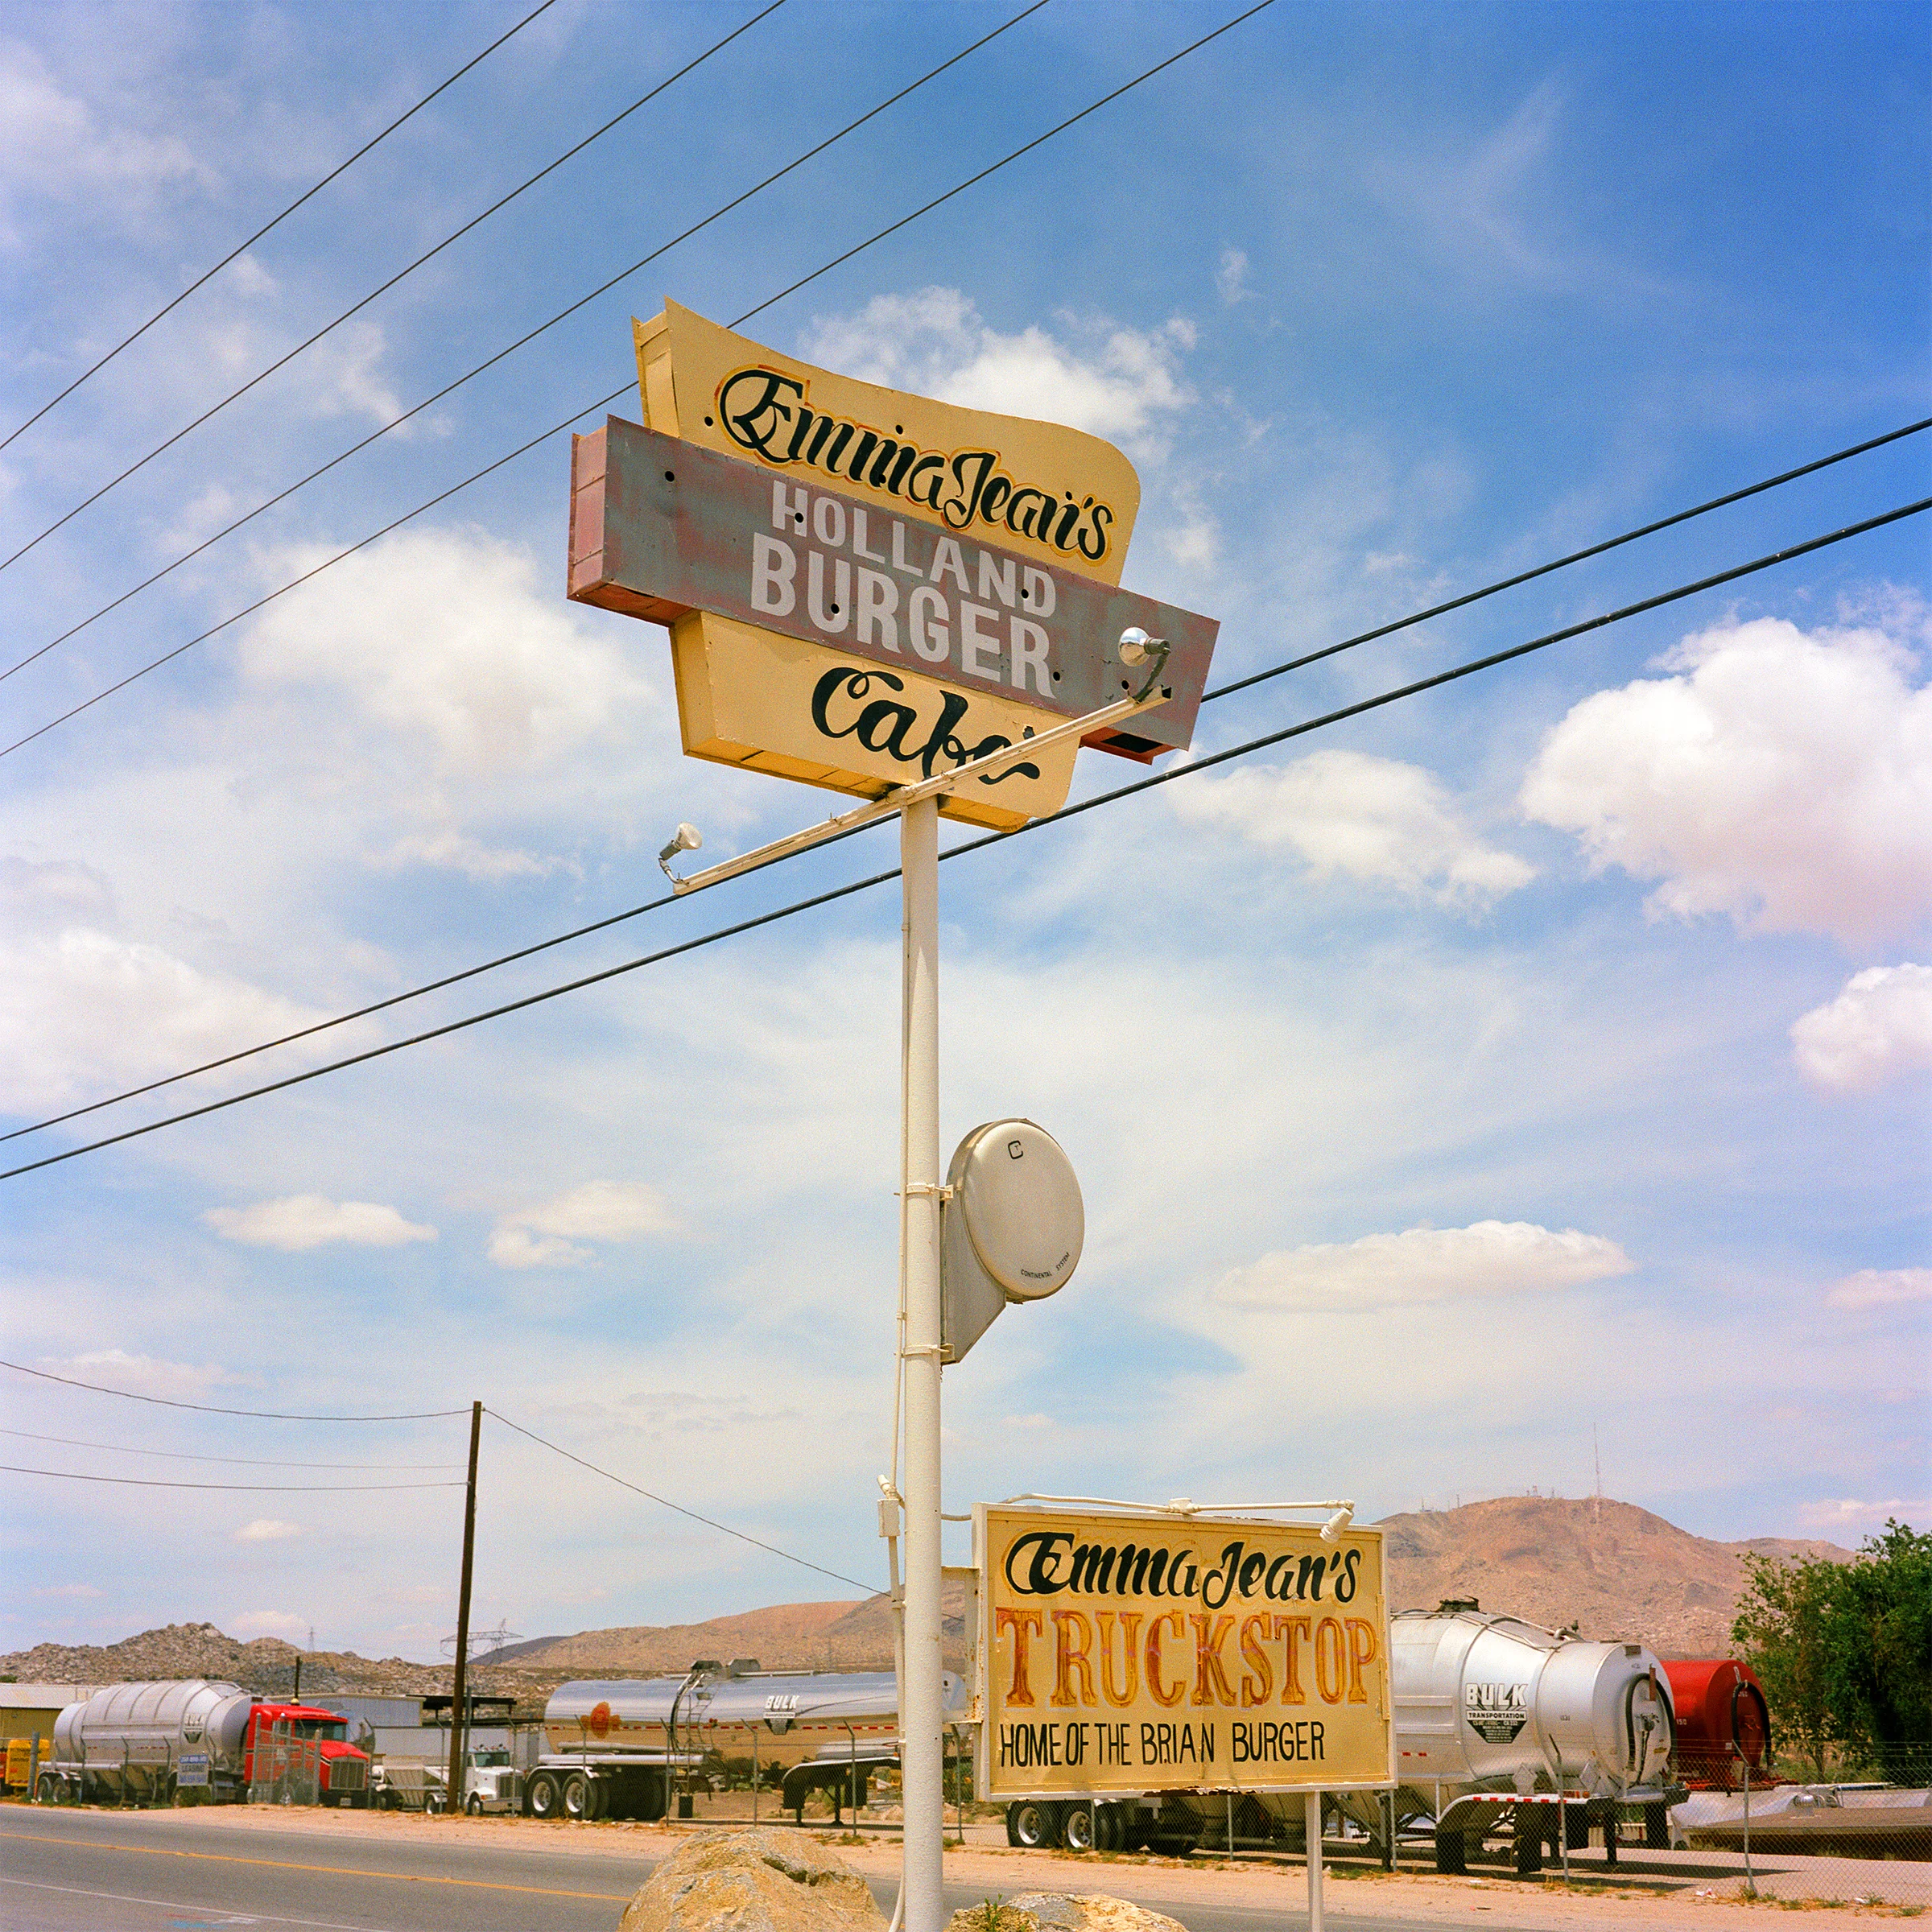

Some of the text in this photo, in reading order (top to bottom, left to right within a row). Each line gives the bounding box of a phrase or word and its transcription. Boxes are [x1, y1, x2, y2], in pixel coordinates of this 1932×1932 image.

[772, 480, 1057, 619] HOLLAND
[750, 532, 1058, 700] BURGER
[1021, 1252, 1070, 1279] CONTINENTAL SYSTEM
[1005, 1531, 1361, 1610] Emma Jean's
[996, 1606, 1377, 1708] TRUCKSTOP
[765, 1695, 800, 1709] BULK
[1466, 1682, 1529, 1707] BULK
[1468, 1711, 1525, 1719] TRANSPORTATION
[1000, 1720, 1325, 1768] HOME OF THE BRIAN BURGER
